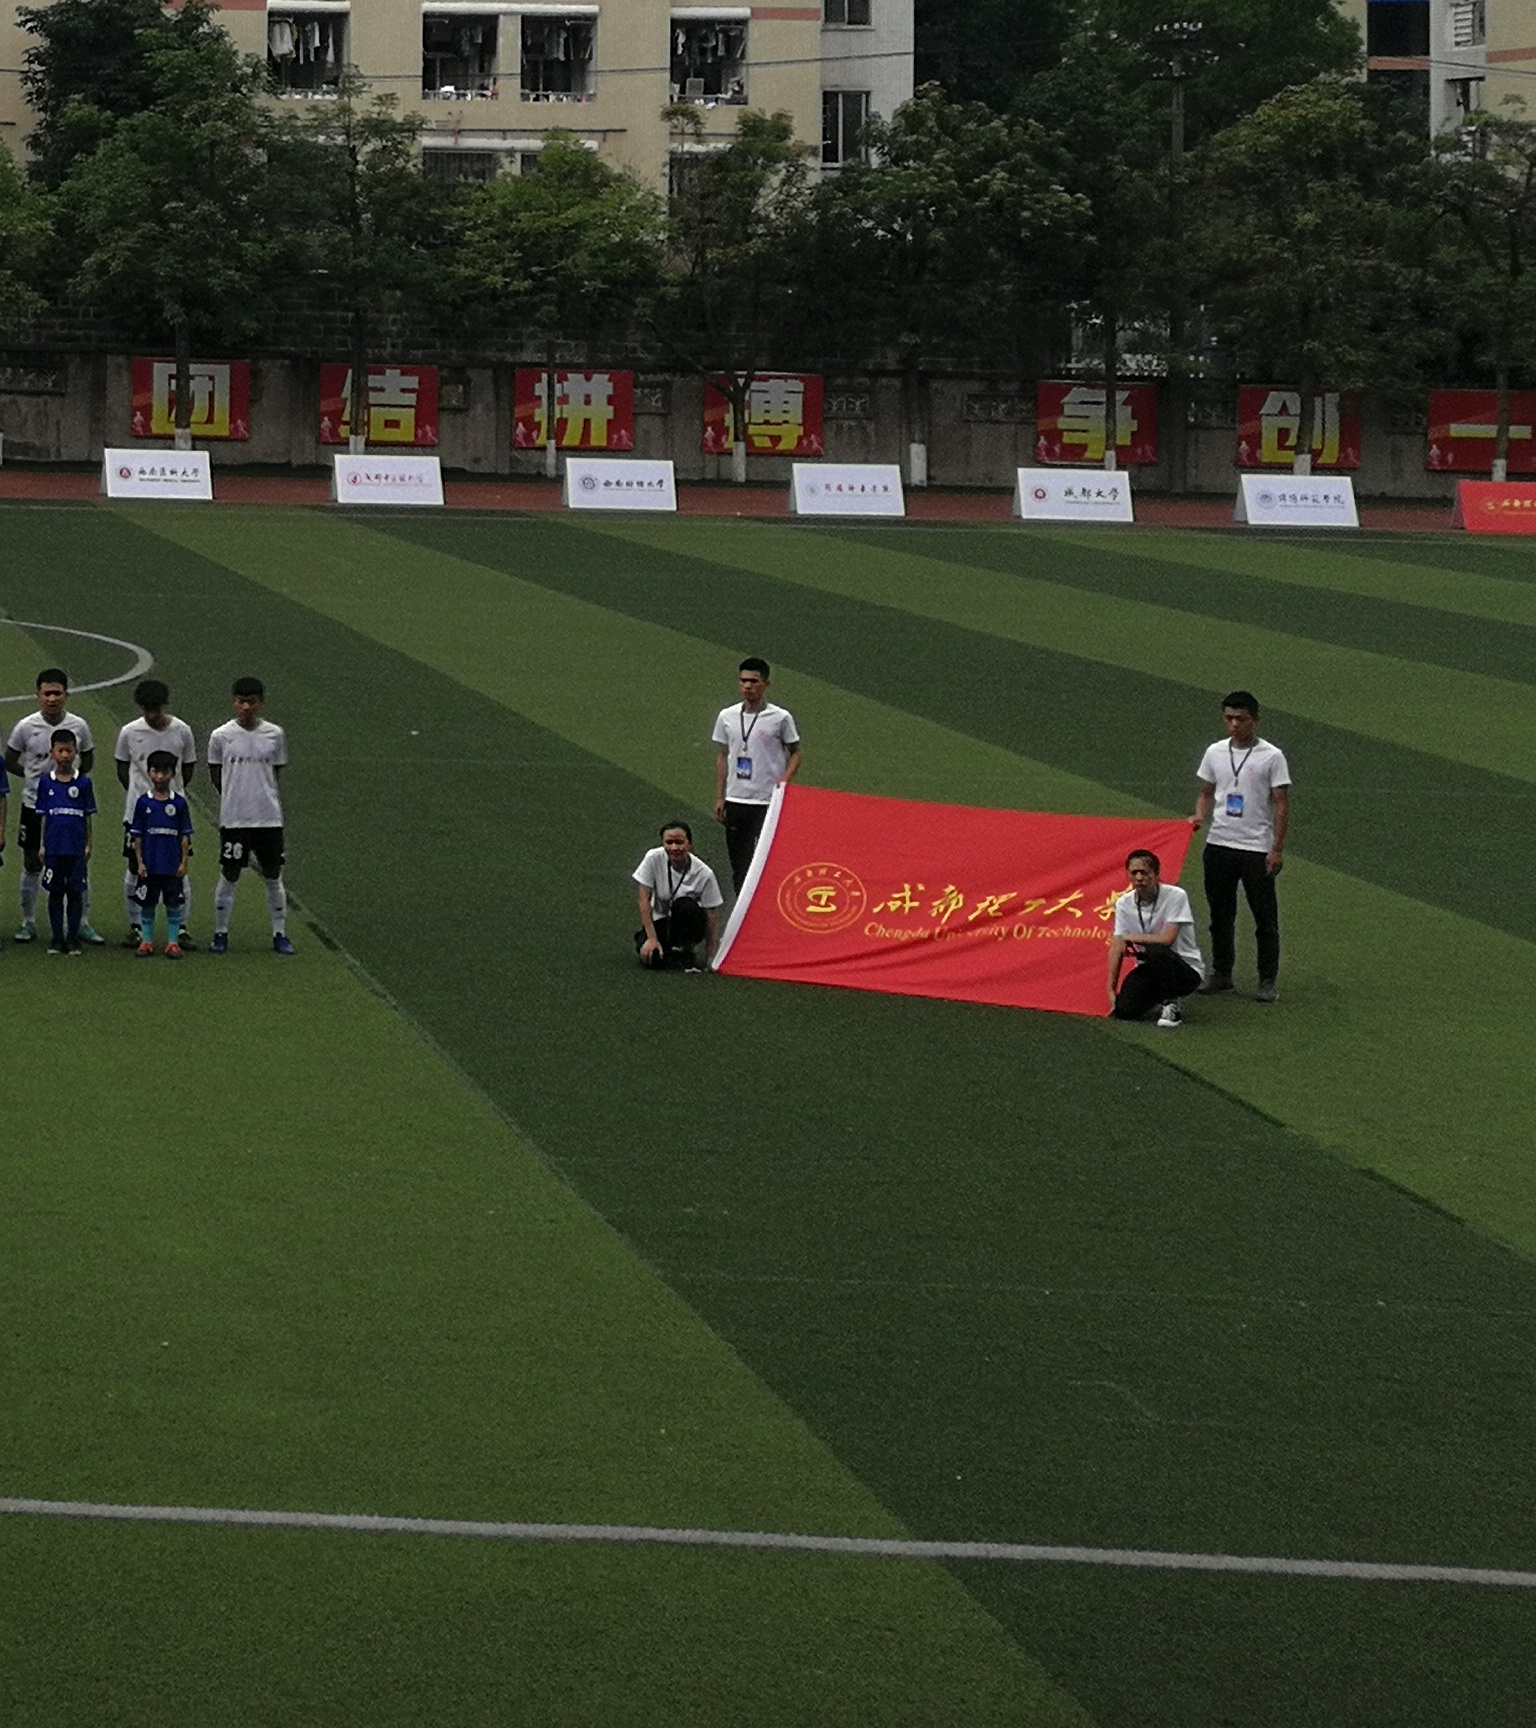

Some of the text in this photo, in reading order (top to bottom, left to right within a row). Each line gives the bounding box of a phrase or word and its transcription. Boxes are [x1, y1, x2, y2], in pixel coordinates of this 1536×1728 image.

[151, 363, 230, 437] 团
[339, 369, 418, 441] 结
[534, 373, 613, 446] 拼
[1057, 387, 1137, 460] 争
